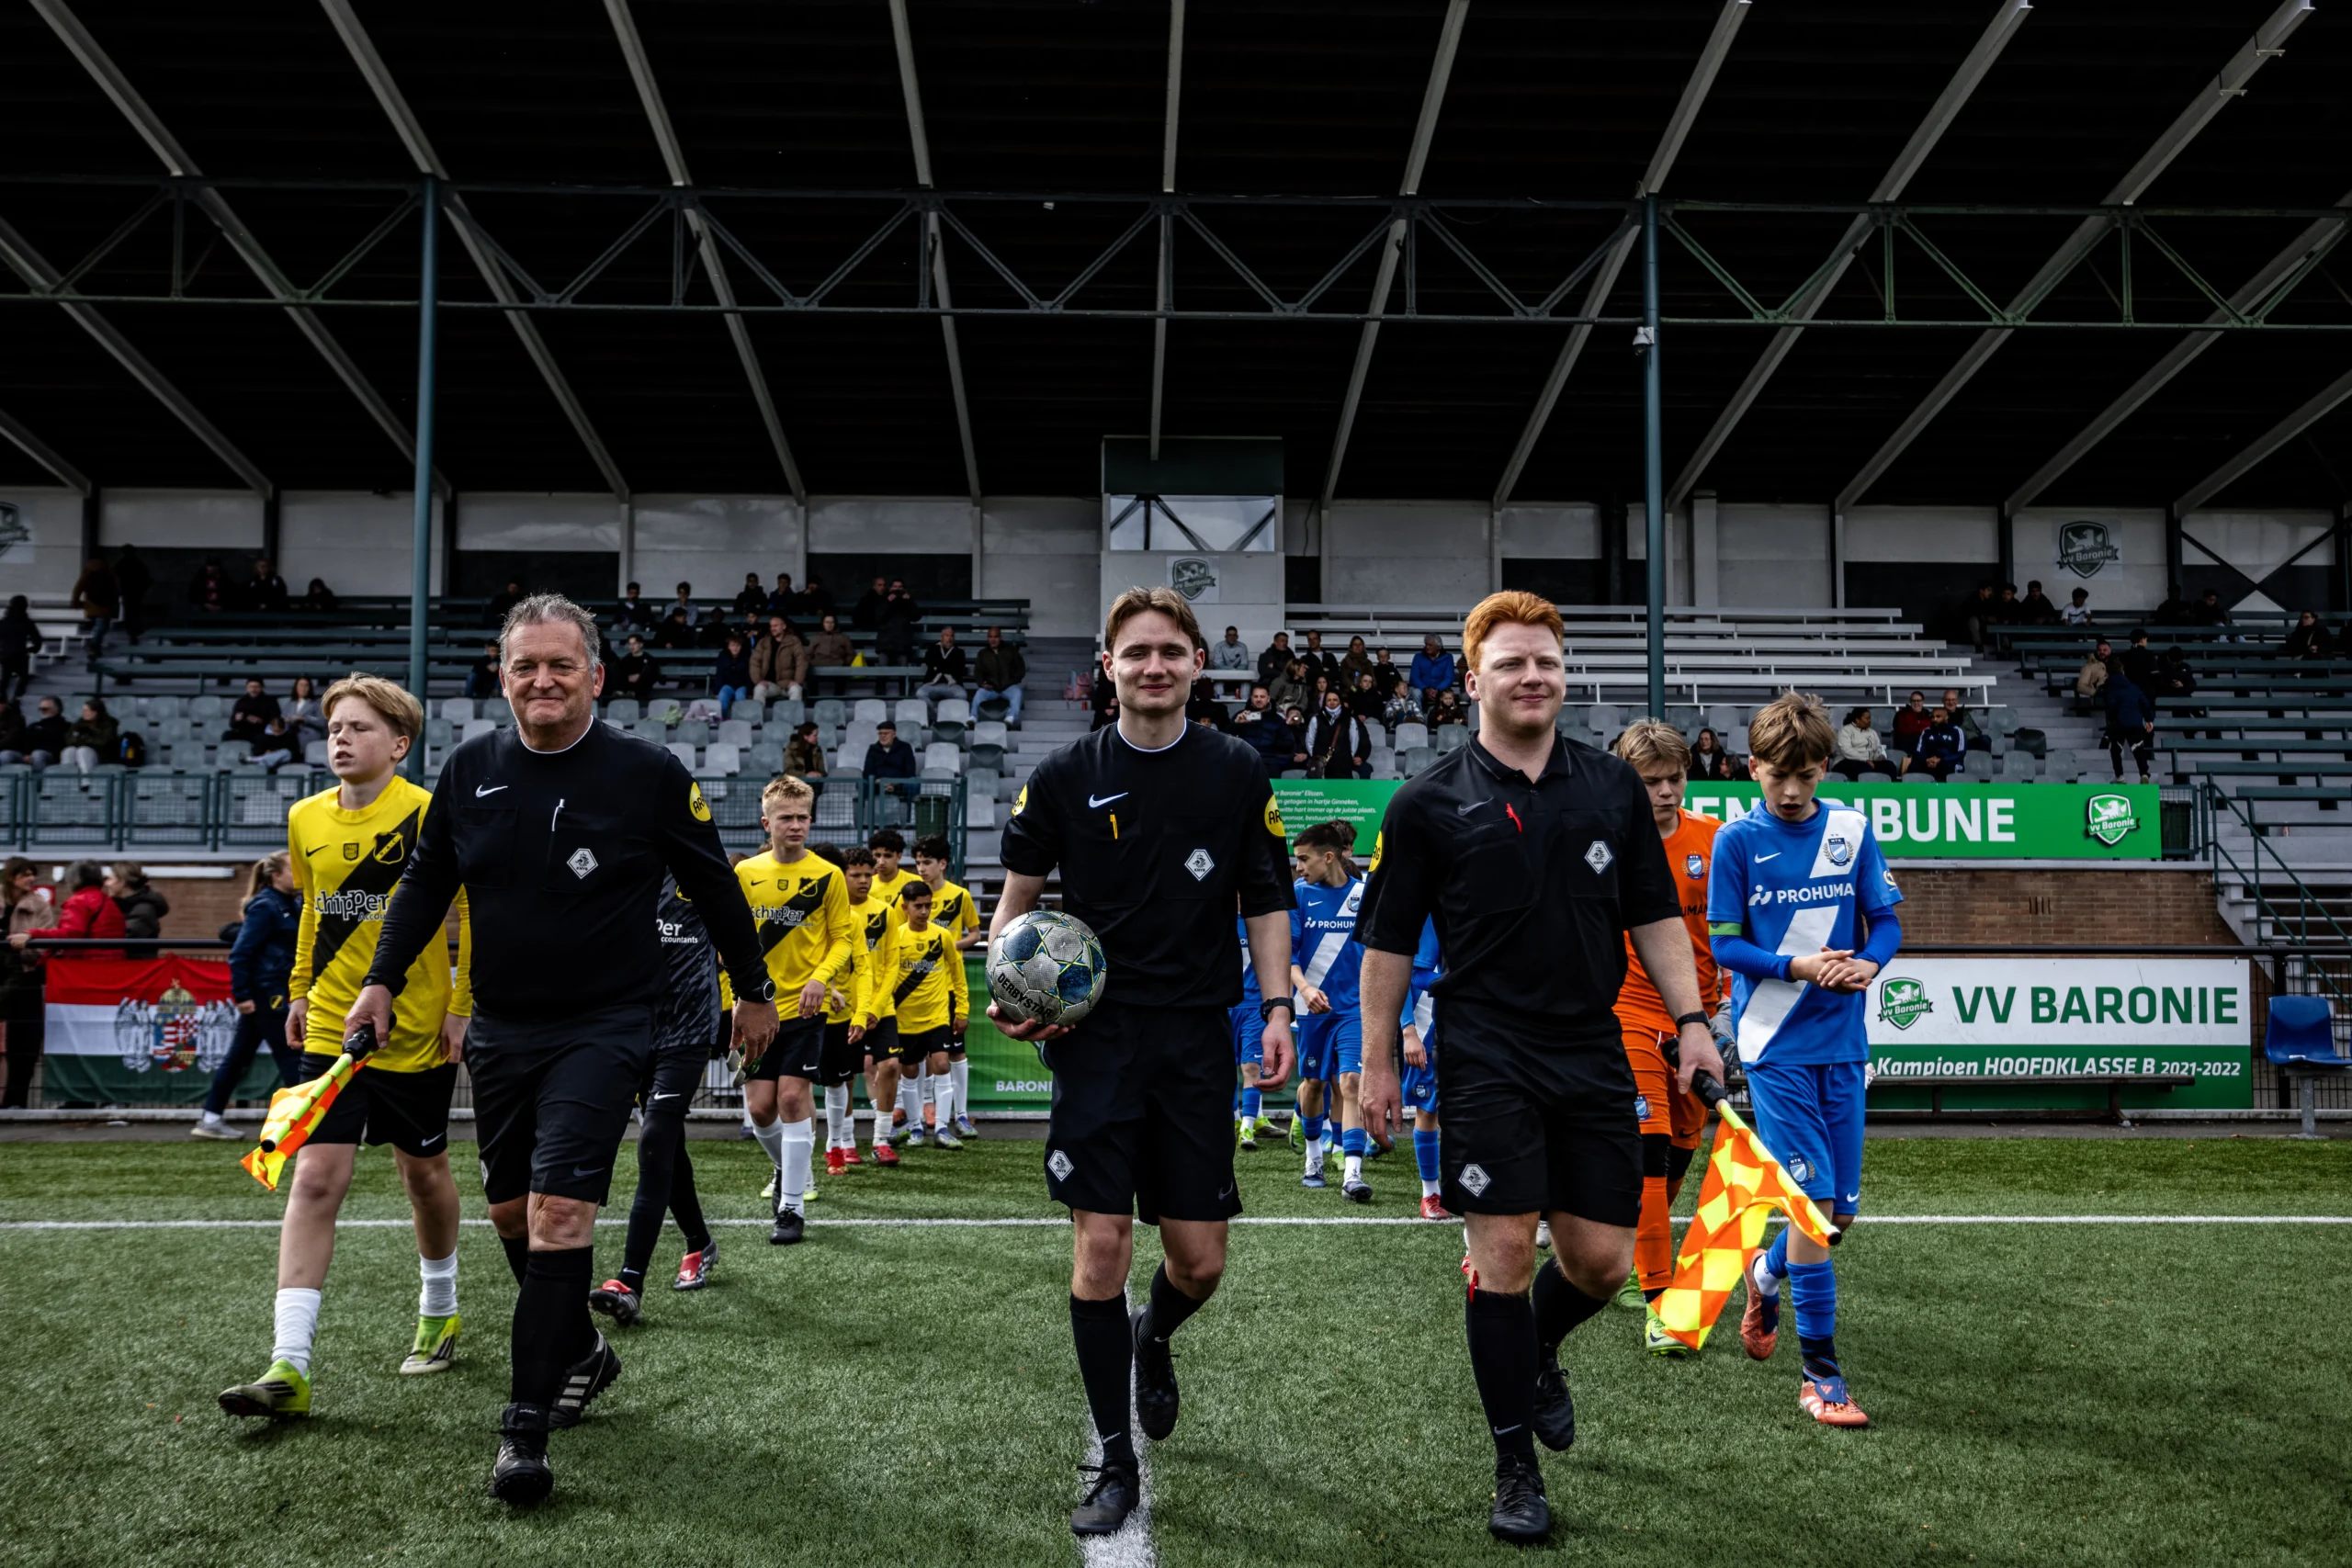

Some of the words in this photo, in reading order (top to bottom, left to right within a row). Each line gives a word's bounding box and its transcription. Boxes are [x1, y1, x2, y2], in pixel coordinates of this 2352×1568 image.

[2075, 547, 2112, 561] Baronie
[2102, 817, 2134, 829] Baronie
[1776, 882, 1856, 904] PROHUMA
[661, 936, 698, 944] ccountants
[997, 972, 1054, 1018] DERBYSTAR
[1894, 1001, 1928, 1015] Baronie
[1951, 986, 2017, 1024] VV
[2030, 986, 2239, 1024] BARONIE
[1876, 1056, 1979, 1077] Kampioen
[1984, 1057, 2137, 1076] HOOFDKLASSE
[2142, 1057, 2155, 1075] B
[2160, 1062, 2241, 1077] 2021-2022
